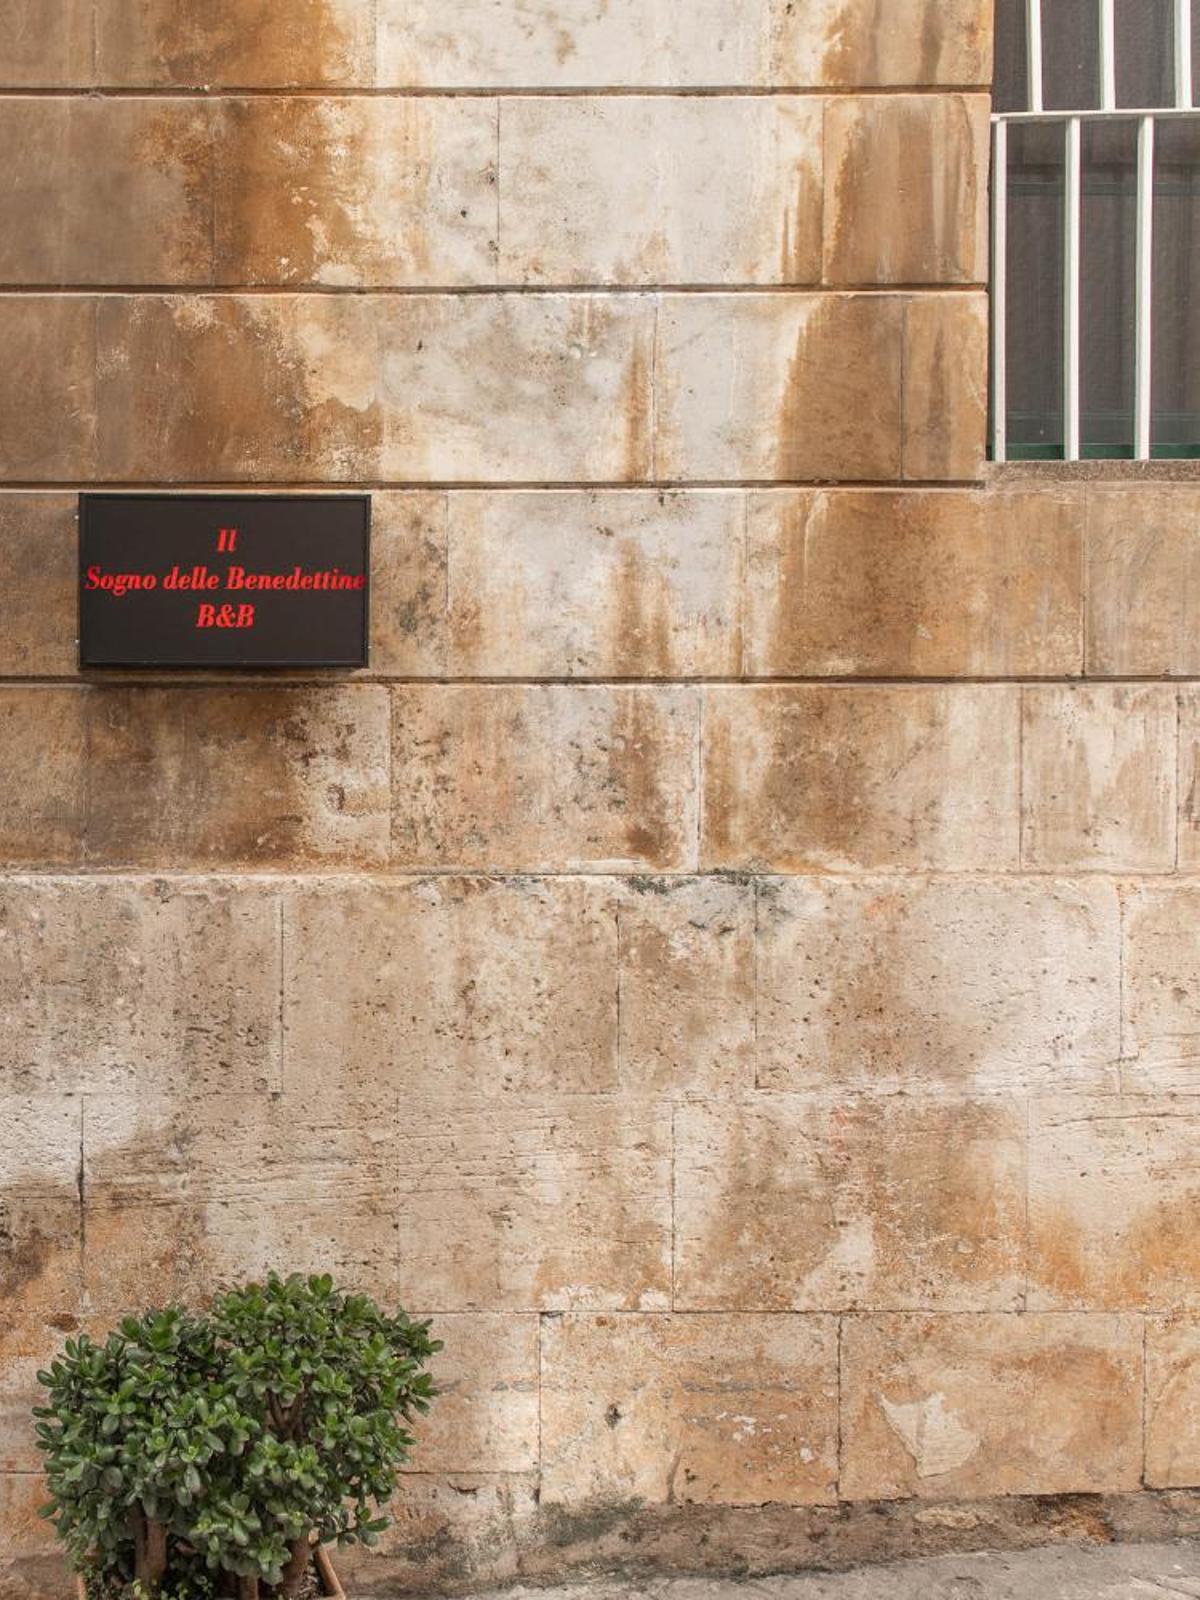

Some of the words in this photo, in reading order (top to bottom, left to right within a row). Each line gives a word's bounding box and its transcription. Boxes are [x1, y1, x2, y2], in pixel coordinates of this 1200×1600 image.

[217, 528, 238, 553] Il
[84, 566, 157, 597] Sogno
[162, 565, 220, 591] delle
[225, 565, 366, 591] Benedettine
[196, 602, 256, 628] B&B
